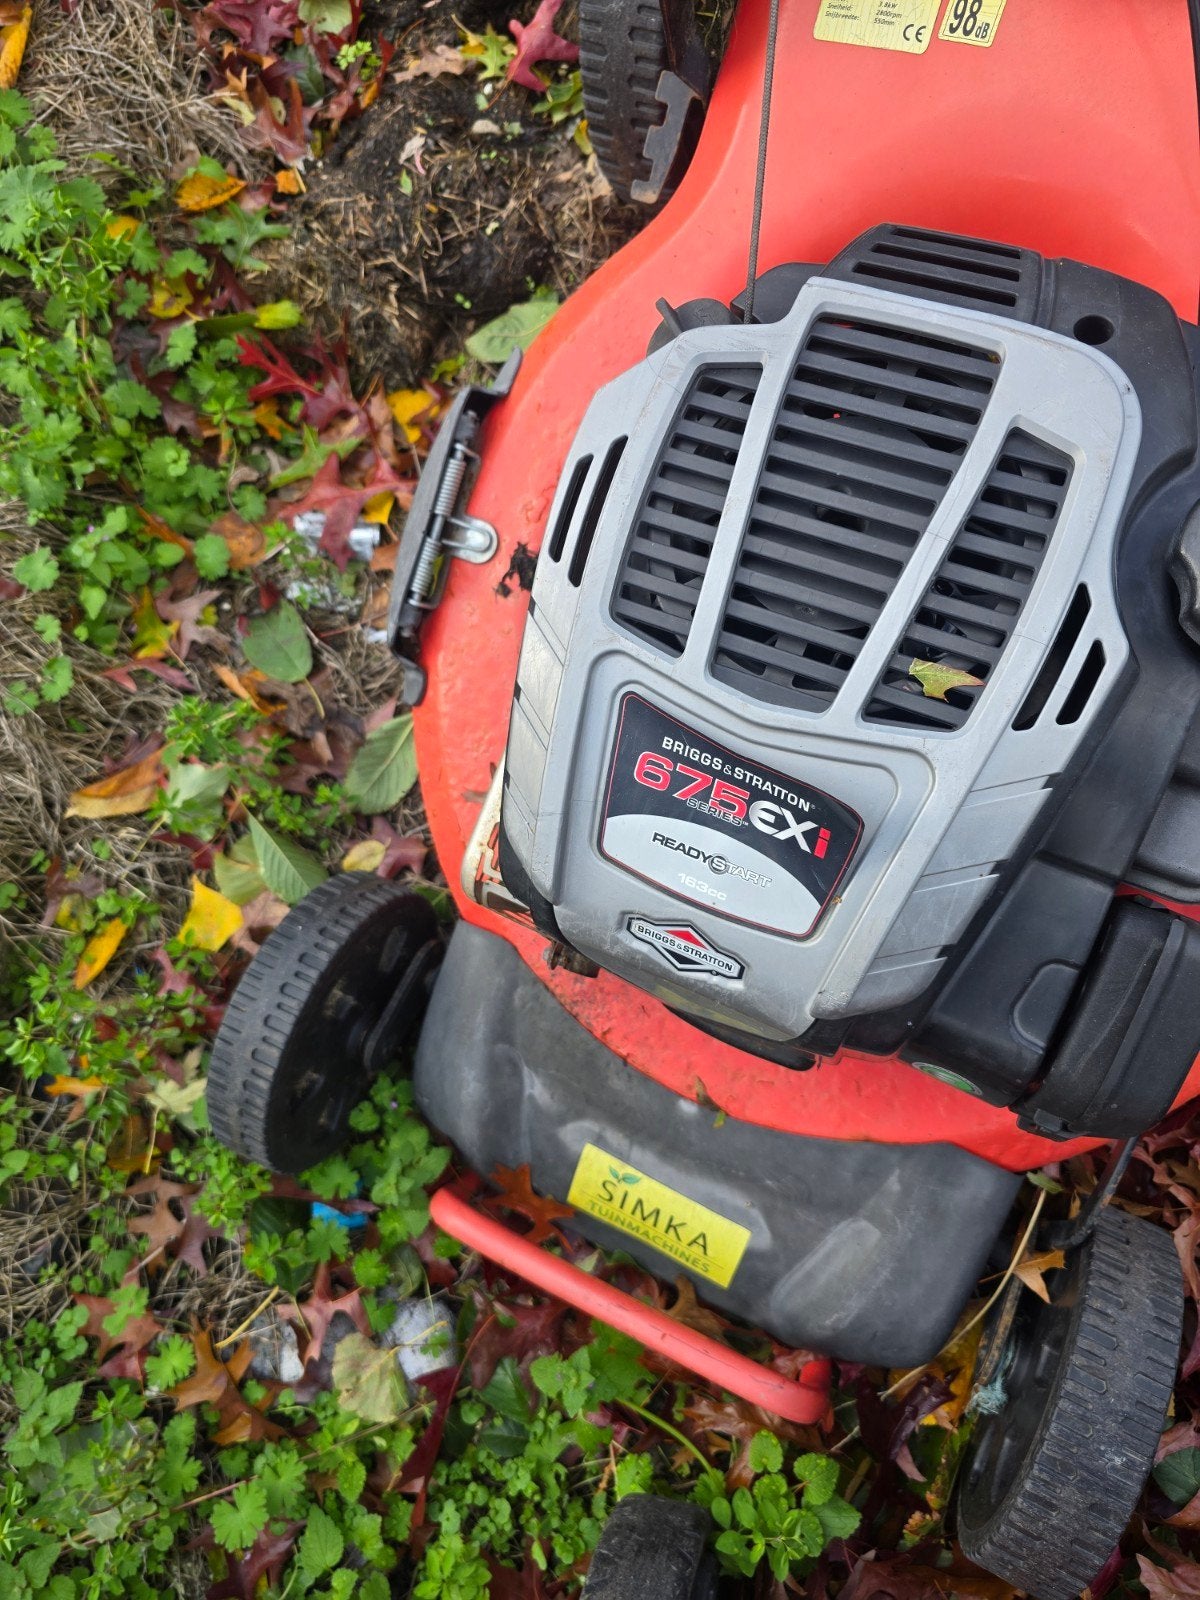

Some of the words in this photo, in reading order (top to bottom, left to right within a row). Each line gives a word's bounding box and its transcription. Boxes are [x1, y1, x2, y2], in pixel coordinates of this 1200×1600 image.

[825, 11, 860, 20] Snijbreedte:
[827, 2, 853, 11] Snelheid:
[949, 0, 983, 36] 98
[902, 23, 927, 43] CE
[633, 751, 751, 820] 675
[677, 873, 728, 901] 163cc
[598, 1179, 709, 1257] SIMKA
[588, 1199, 711, 1273] TUINMACHINES
